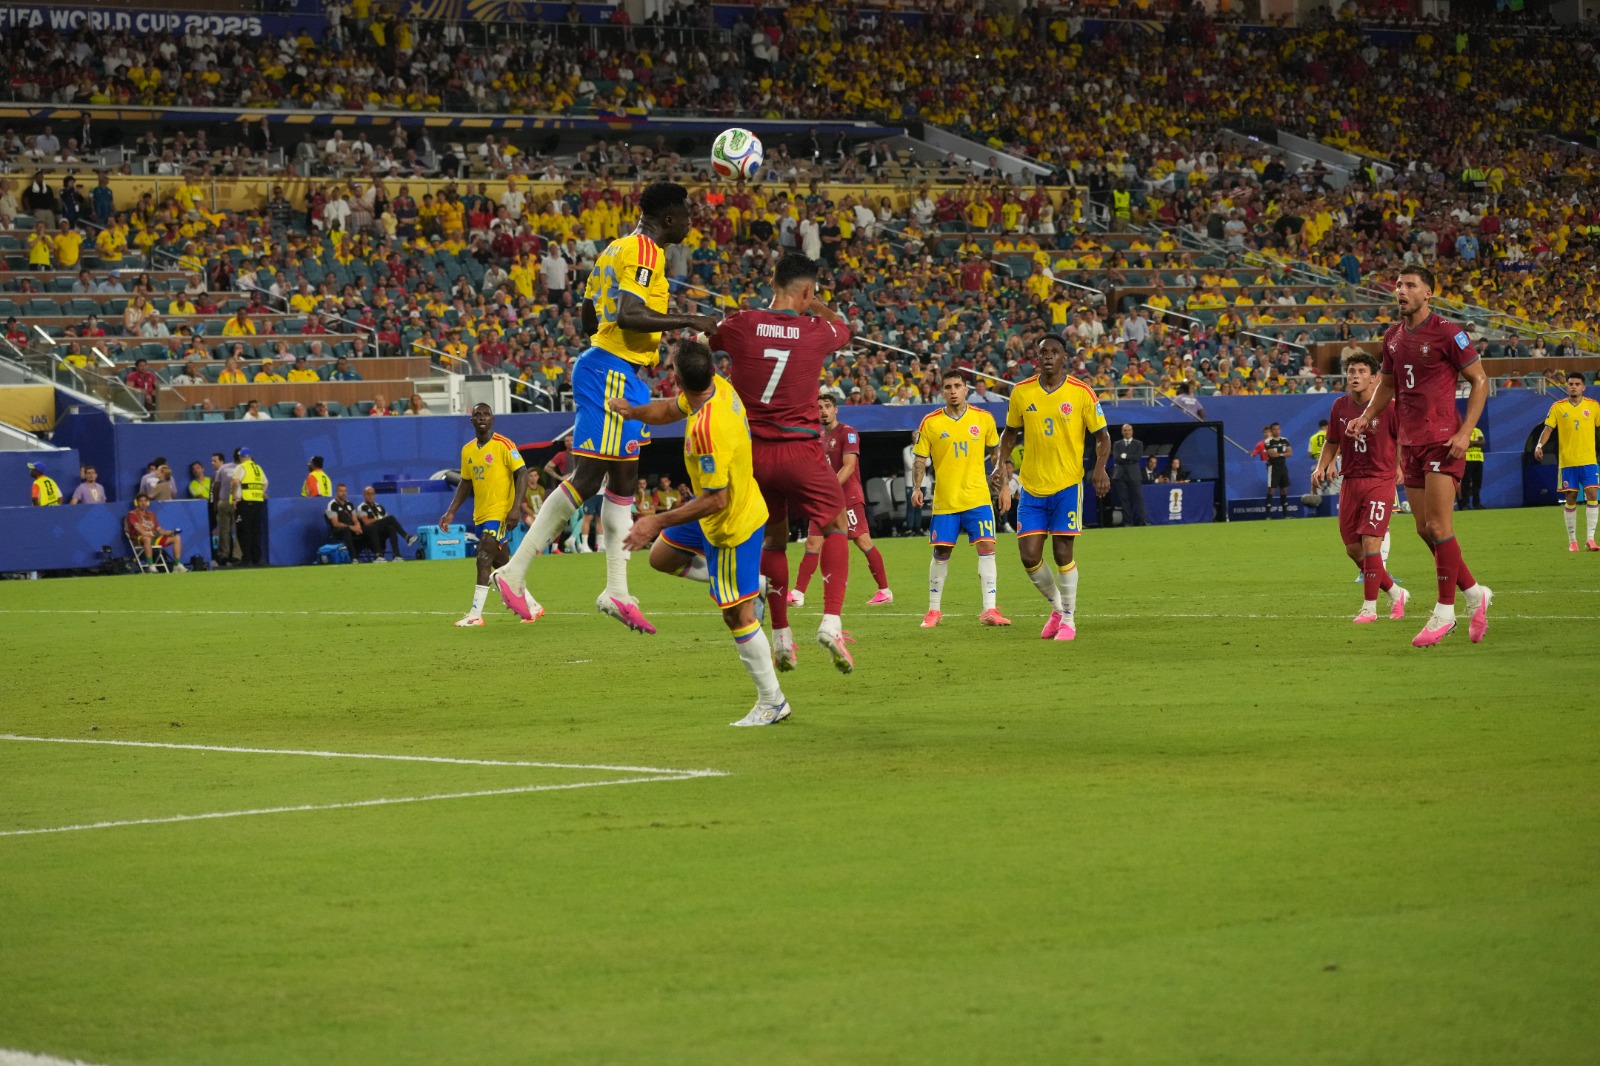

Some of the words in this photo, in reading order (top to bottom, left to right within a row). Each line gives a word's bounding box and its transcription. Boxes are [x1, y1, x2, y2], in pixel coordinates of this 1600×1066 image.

[0, 8, 44, 28] FIFA
[50, 10, 131, 31] WORLD
[136, 13, 181, 33] CUP
[185, 15, 262, 37] 2026
[756, 323, 800, 340] RONALDO
[760, 348, 792, 404] 7
[1403, 364, 1415, 389] 3
[1044, 417, 1054, 437] 3
[1574, 420, 1580, 431] 7
[953, 440, 968, 458] 14
[1354, 433, 1367, 453] 15
[473, 465, 485, 480] 22
[847, 509, 858, 527] 8
[1369, 500, 1386, 521] 15
[978, 520, 994, 537] 14
[1067, 511, 1077, 530] 3
